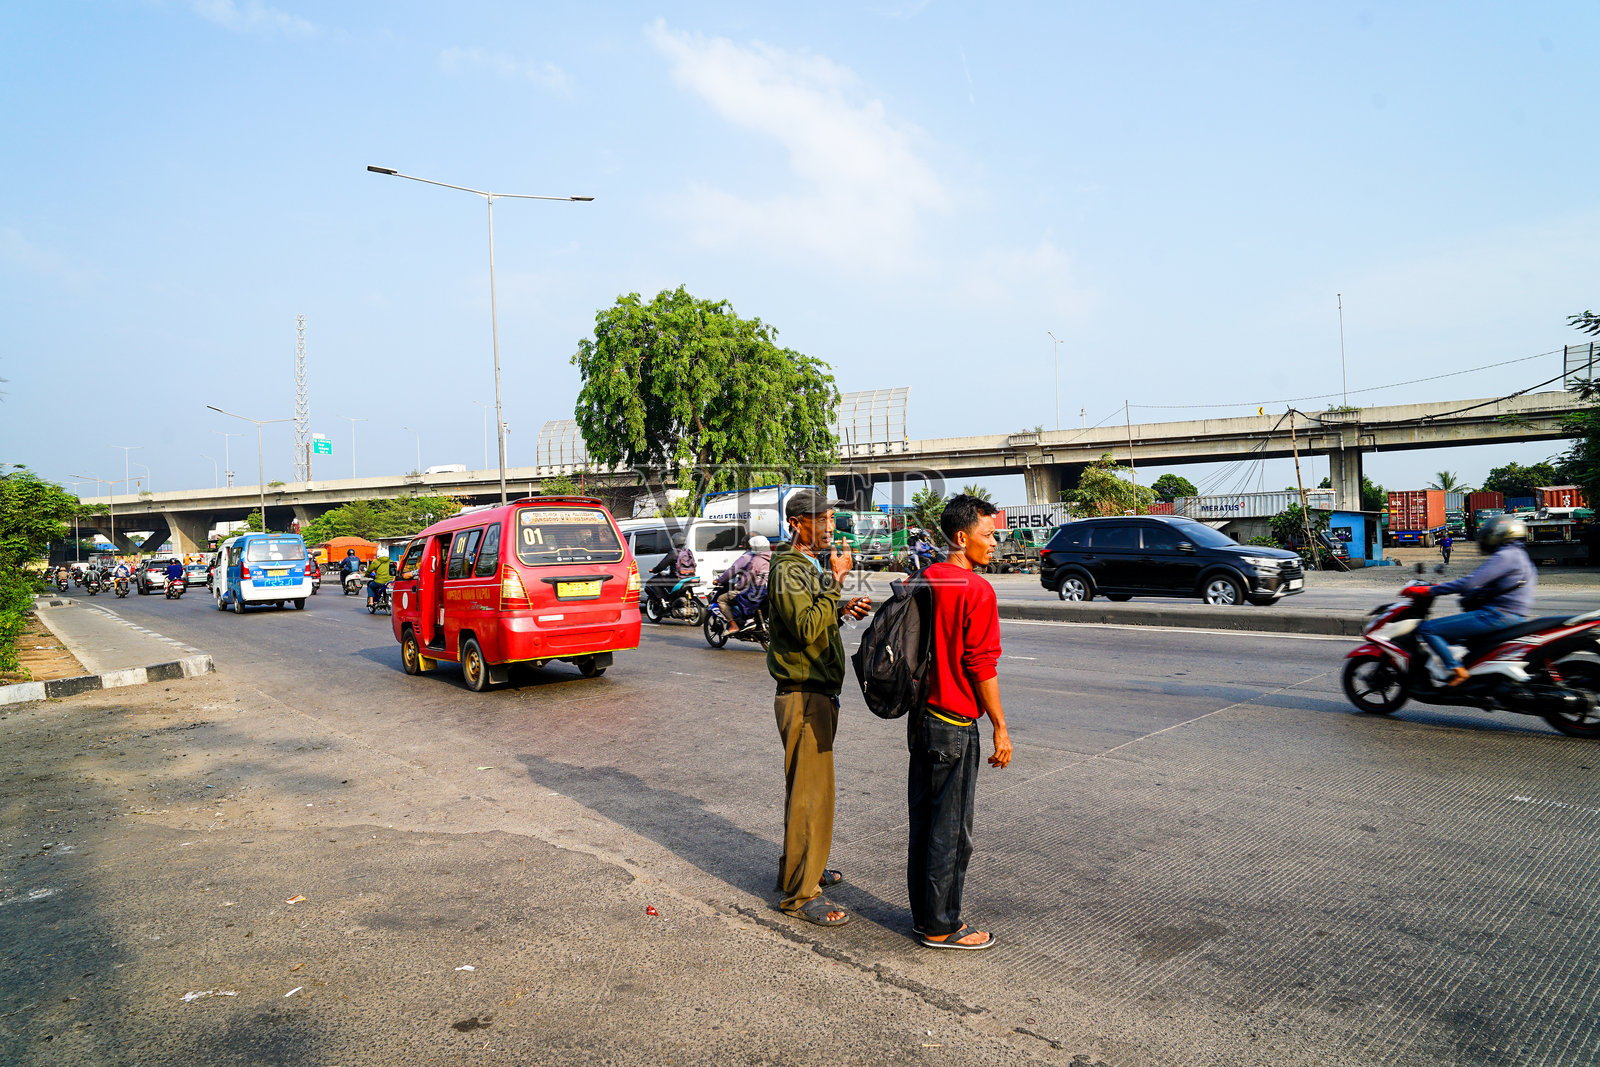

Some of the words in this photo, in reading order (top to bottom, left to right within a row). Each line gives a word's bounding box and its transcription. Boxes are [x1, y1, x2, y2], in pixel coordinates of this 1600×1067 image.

[1201, 504, 1240, 512] MERATUS
[523, 527, 544, 546] 01
[456, 537, 466, 554] 01
